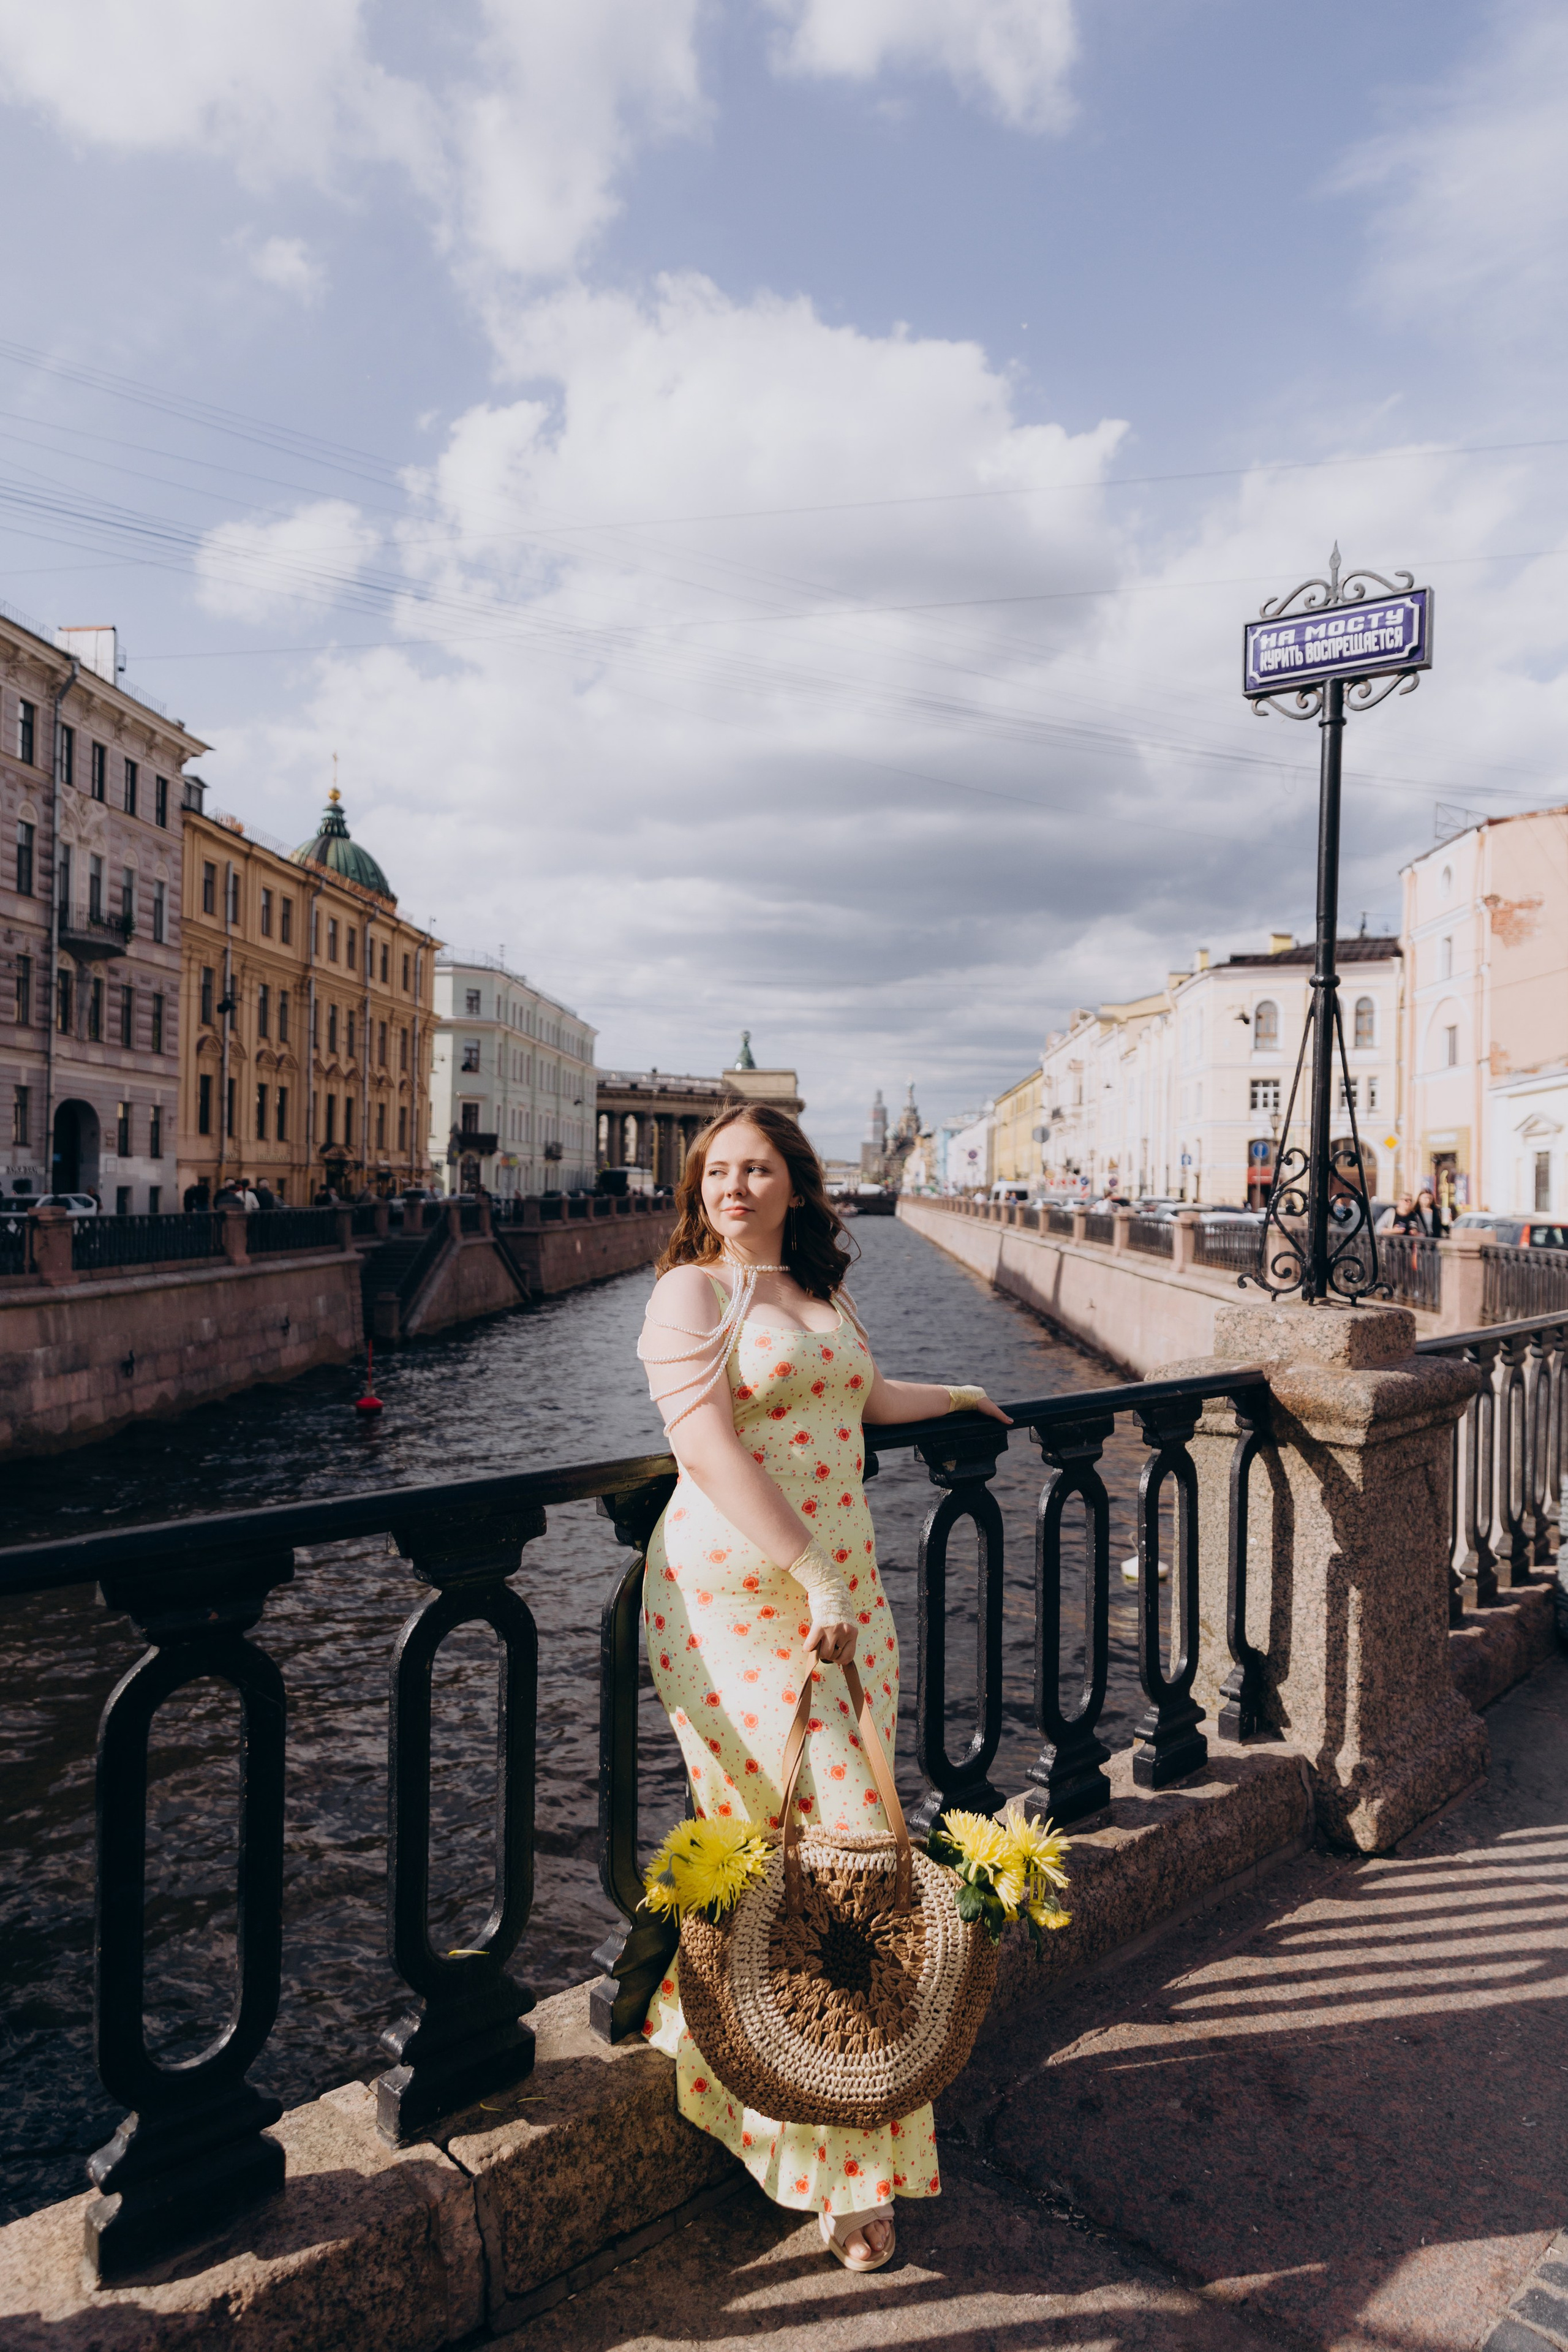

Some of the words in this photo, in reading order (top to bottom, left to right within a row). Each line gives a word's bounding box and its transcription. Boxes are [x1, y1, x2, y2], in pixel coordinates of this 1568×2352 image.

[1259, 644, 1304, 672] КУРИТЬ
[1305, 625, 1403, 664] ВОСПРЕЩАЕТСЯ
[1260, 629, 1295, 650] НА
[1304, 608, 1404, 641] МОСТУ
